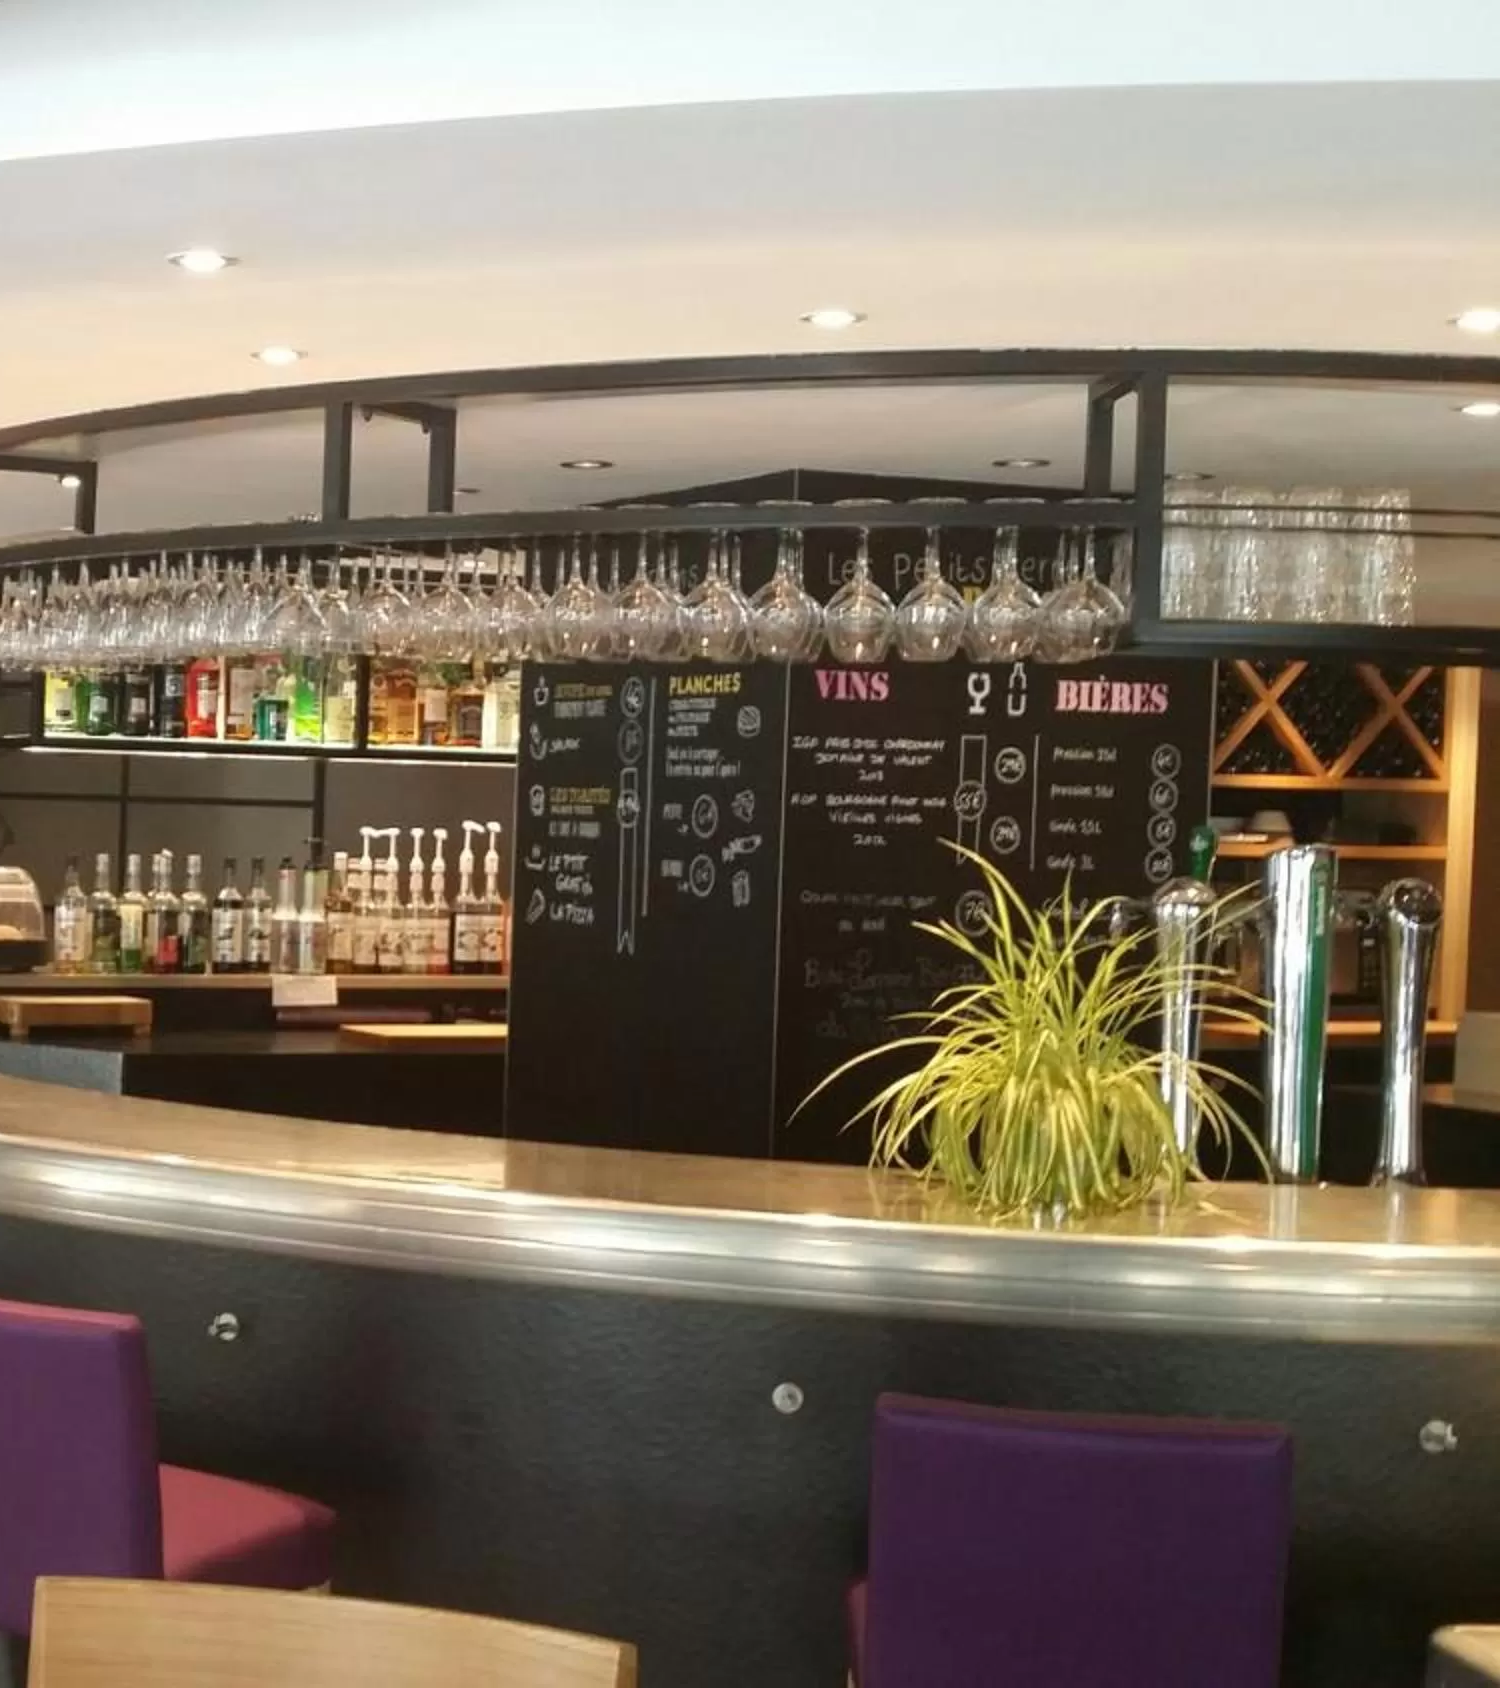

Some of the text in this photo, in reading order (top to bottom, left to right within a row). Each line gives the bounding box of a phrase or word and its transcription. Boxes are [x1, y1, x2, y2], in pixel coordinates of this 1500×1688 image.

[893, 552, 986, 591] Peits
[669, 673, 741, 695] PLANCHES
[815, 669, 890, 701] VINS
[1054, 675, 1169, 714] BIÈRES
